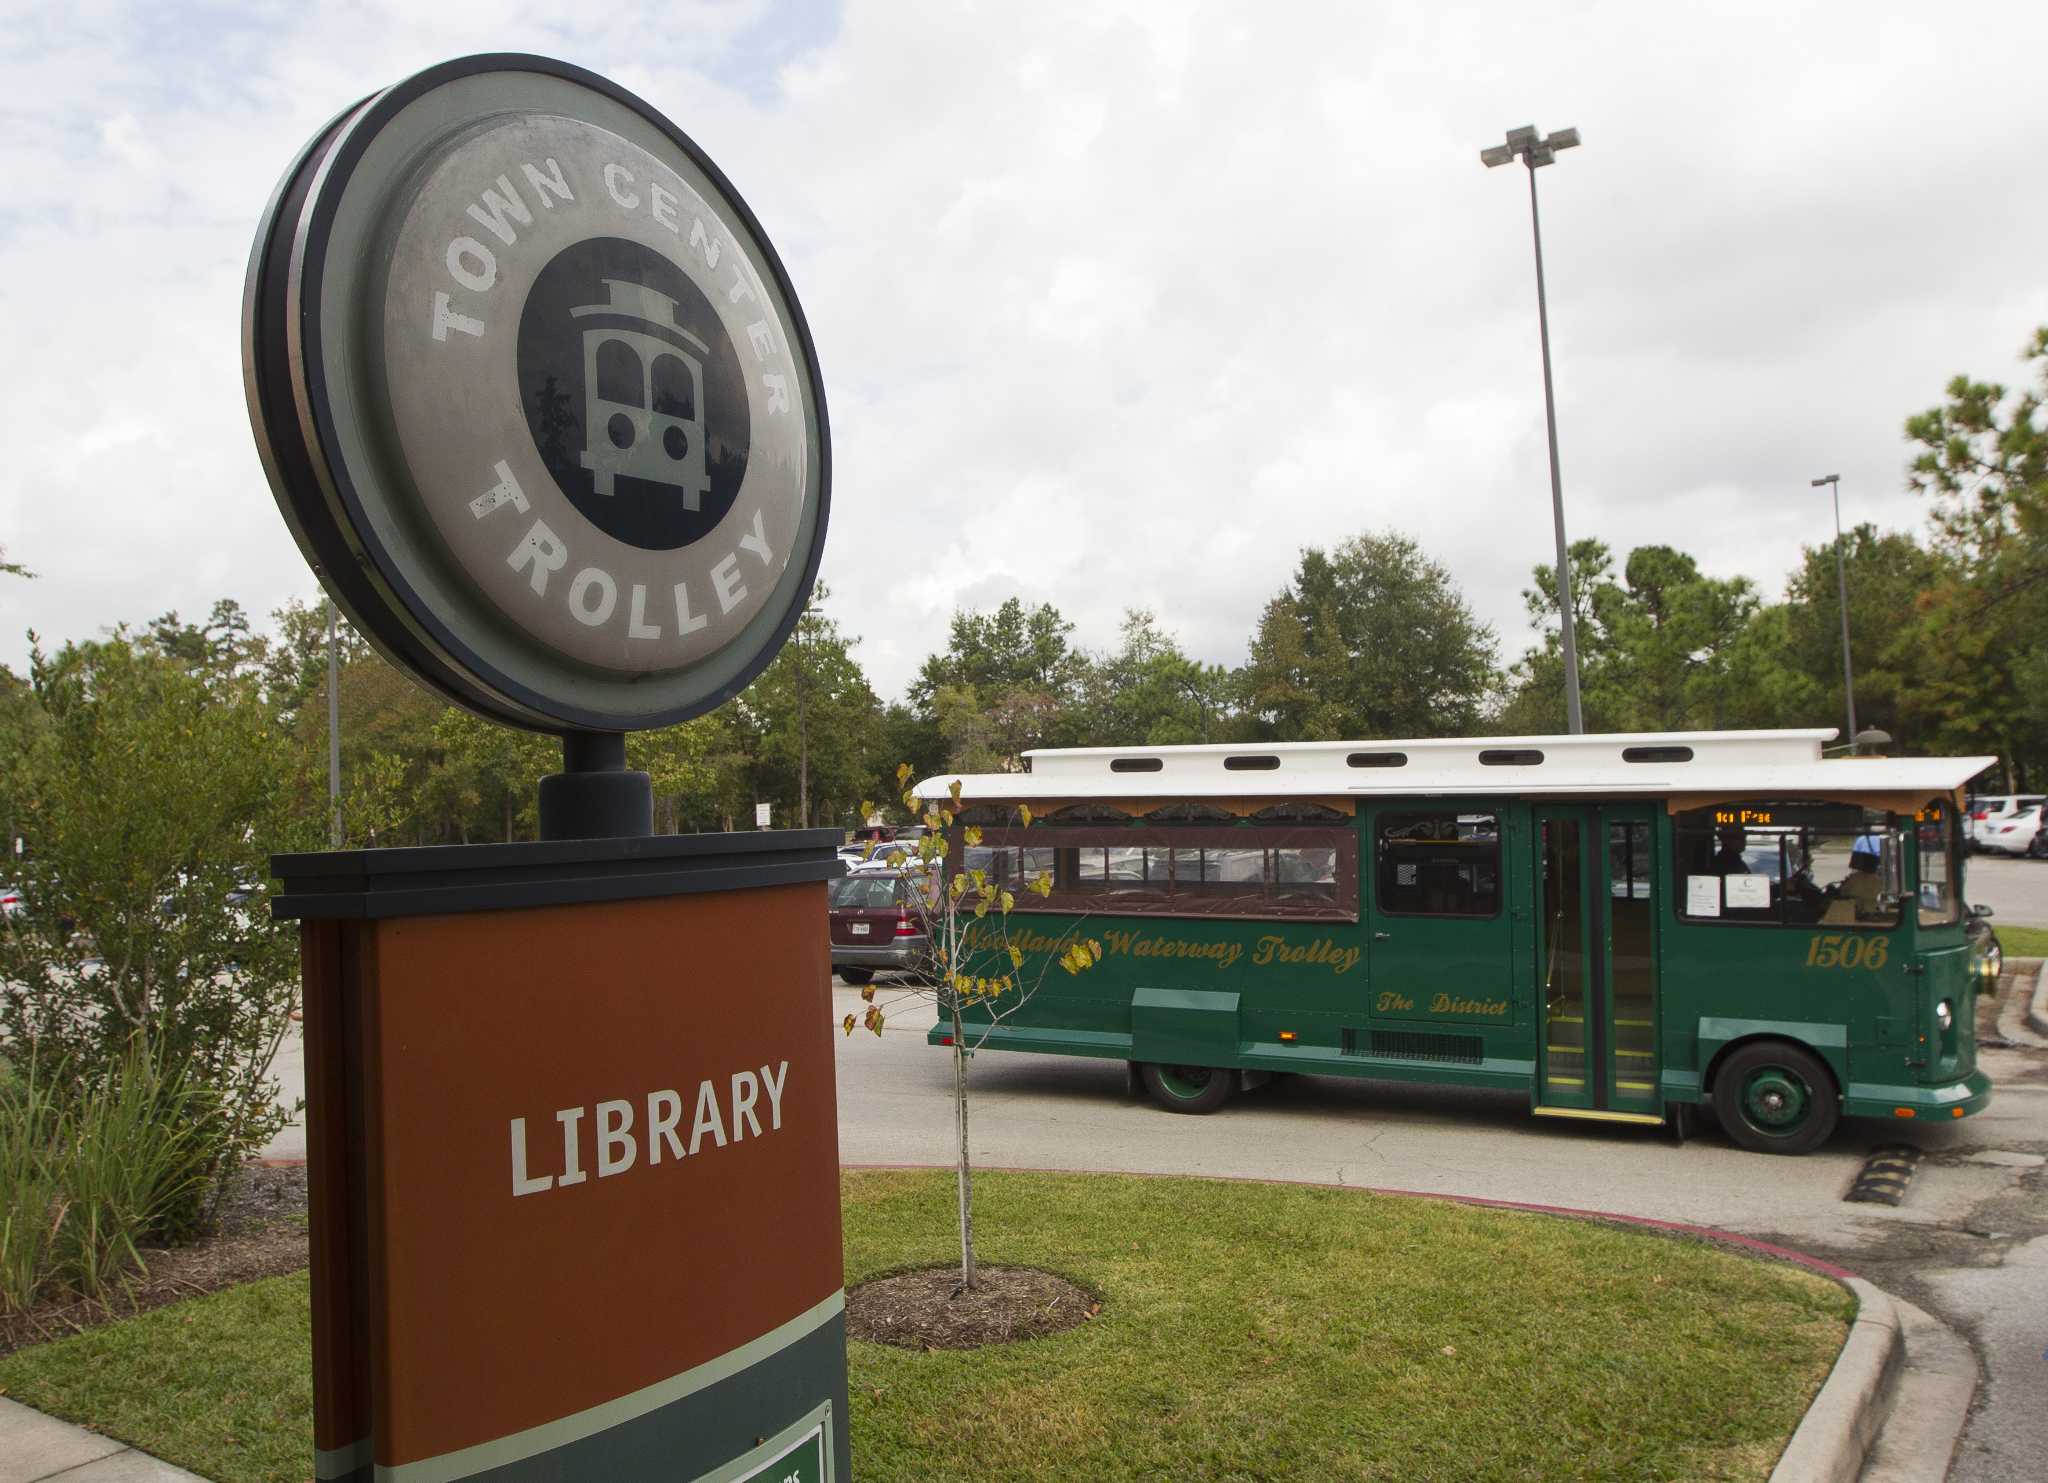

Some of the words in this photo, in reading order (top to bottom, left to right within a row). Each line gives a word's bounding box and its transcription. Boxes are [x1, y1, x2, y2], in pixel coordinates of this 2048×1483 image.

[431, 157, 576, 343] TOWN
[603, 162, 791, 417] CENTER
[467, 459, 775, 640] TROLLEY
[1103, 929, 1243, 969] Waterway
[1252, 935, 1361, 974] Trolley
[1806, 935, 1889, 970] 1506
[1376, 991, 1415, 1011] The
[1430, 992, 1507, 1015] District
[510, 1060, 789, 1197] LIBRARY
